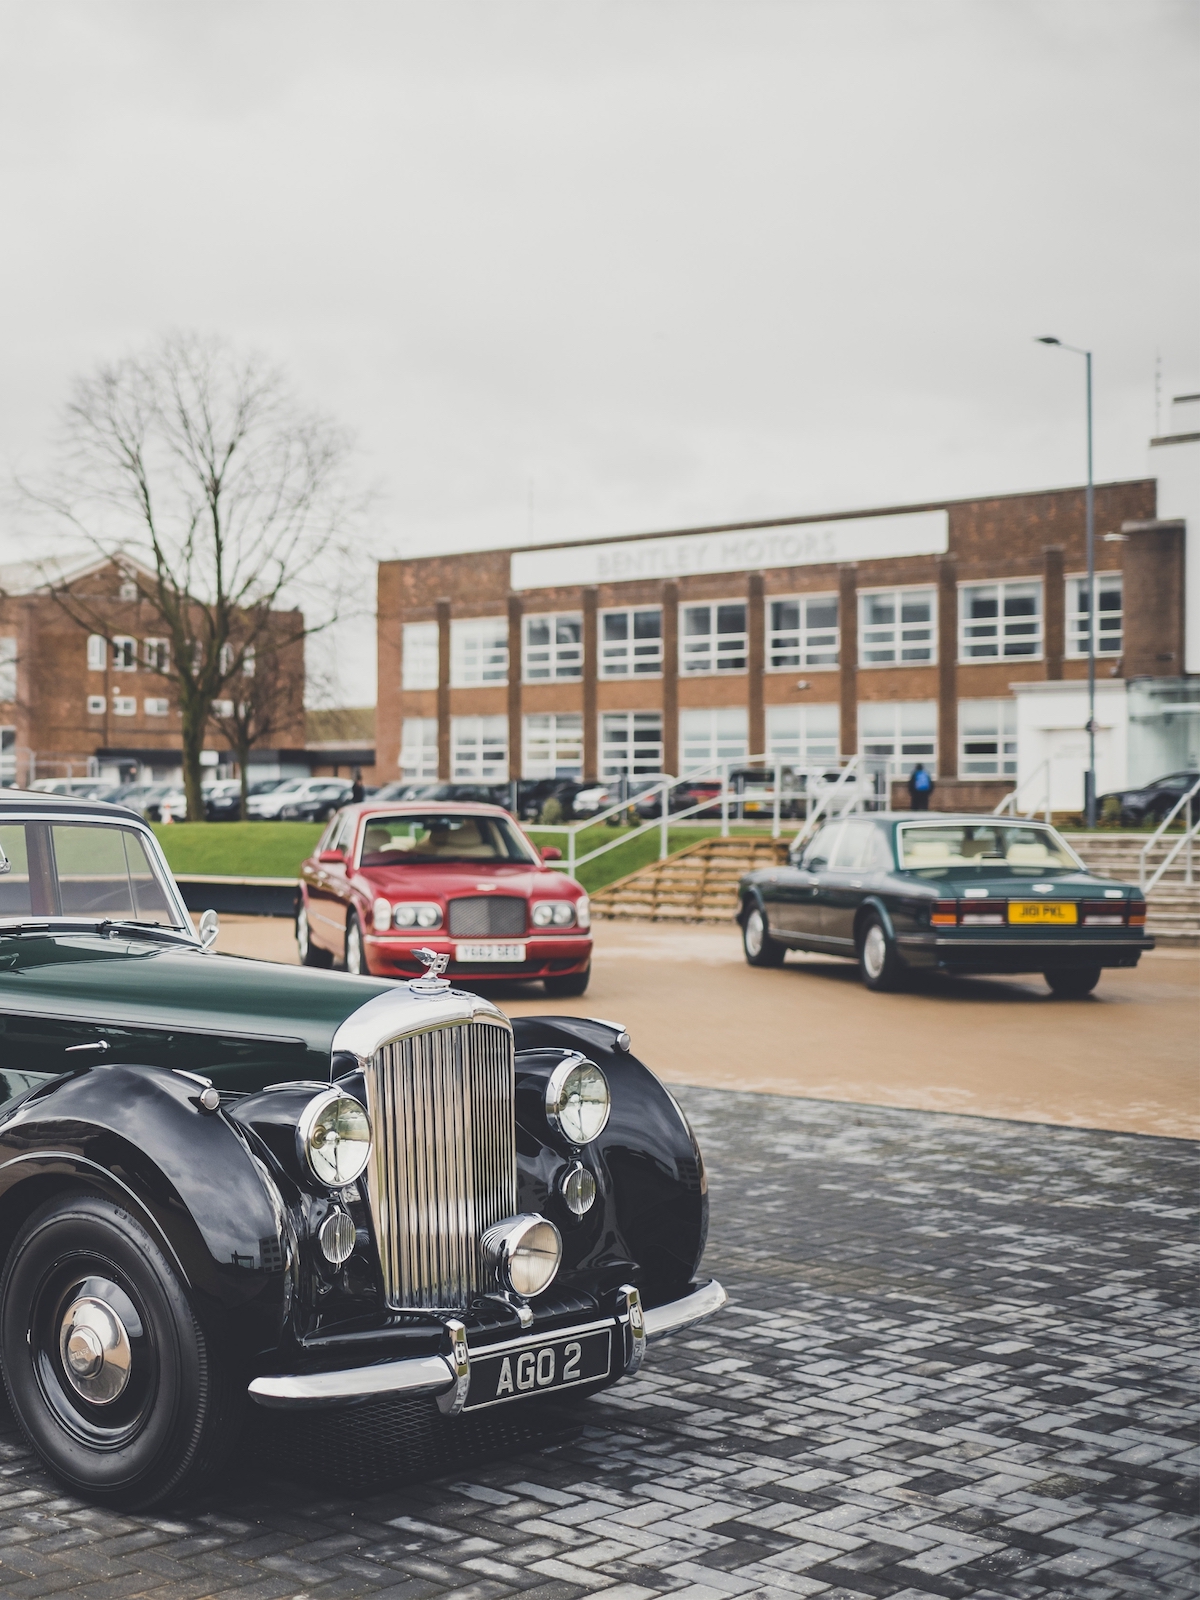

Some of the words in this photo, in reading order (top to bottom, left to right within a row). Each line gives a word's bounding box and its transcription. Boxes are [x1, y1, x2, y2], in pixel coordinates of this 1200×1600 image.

[596, 543, 708, 577] BENTLEY
[720, 530, 837, 563] MOTORS
[496, 1347, 556, 1396] AGO
[563, 1342, 582, 1380] 2
